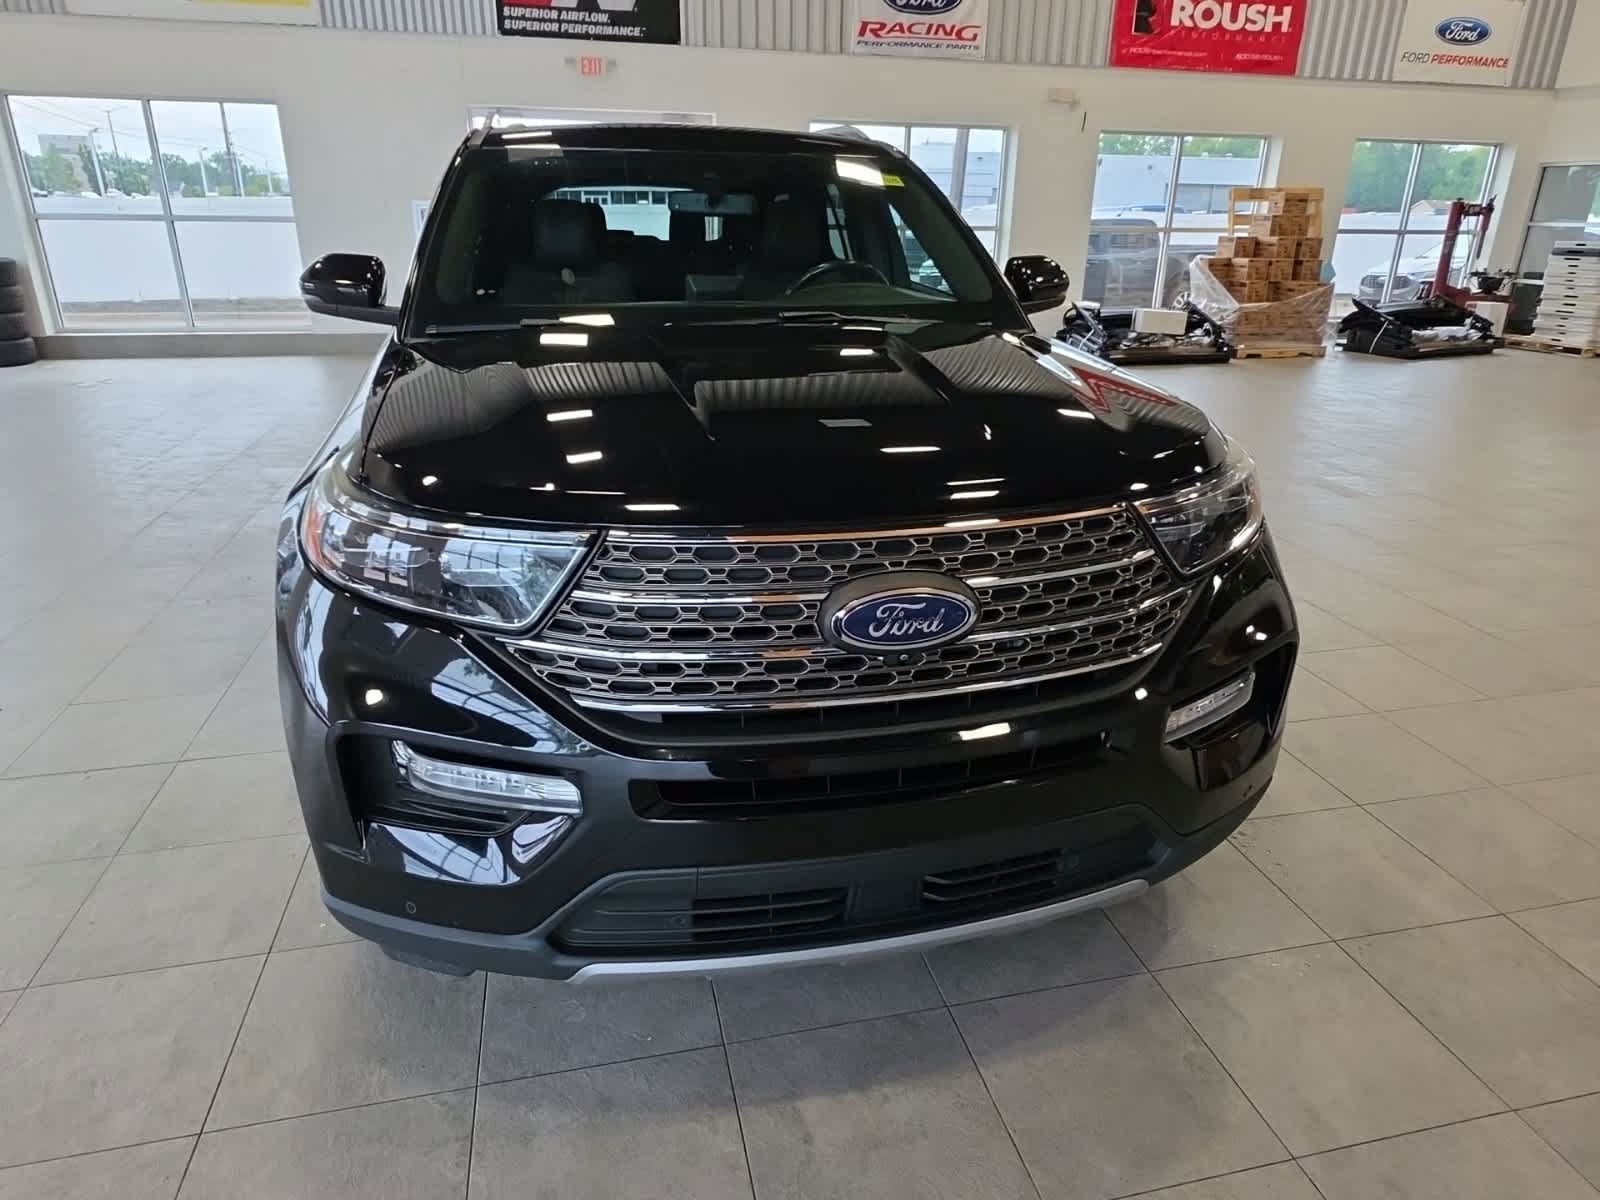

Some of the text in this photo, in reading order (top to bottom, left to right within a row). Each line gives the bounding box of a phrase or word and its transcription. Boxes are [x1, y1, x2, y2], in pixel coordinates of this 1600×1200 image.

[503, 6, 611, 23] SUPERIOR AIRFLOW.
[1170, 0, 1293, 33] ROUSH
[504, 19, 559, 32] SUPERIOR
[857, 20, 982, 42] RACING
[1445, 21, 1480, 41] Ford
[856, 40, 943, 49] PERFORMANCE
[580, 55, 603, 76] EXIT
[1400, 52, 1509, 69] FORD PERFORMANCE
[868, 602, 946, 638] Ford
